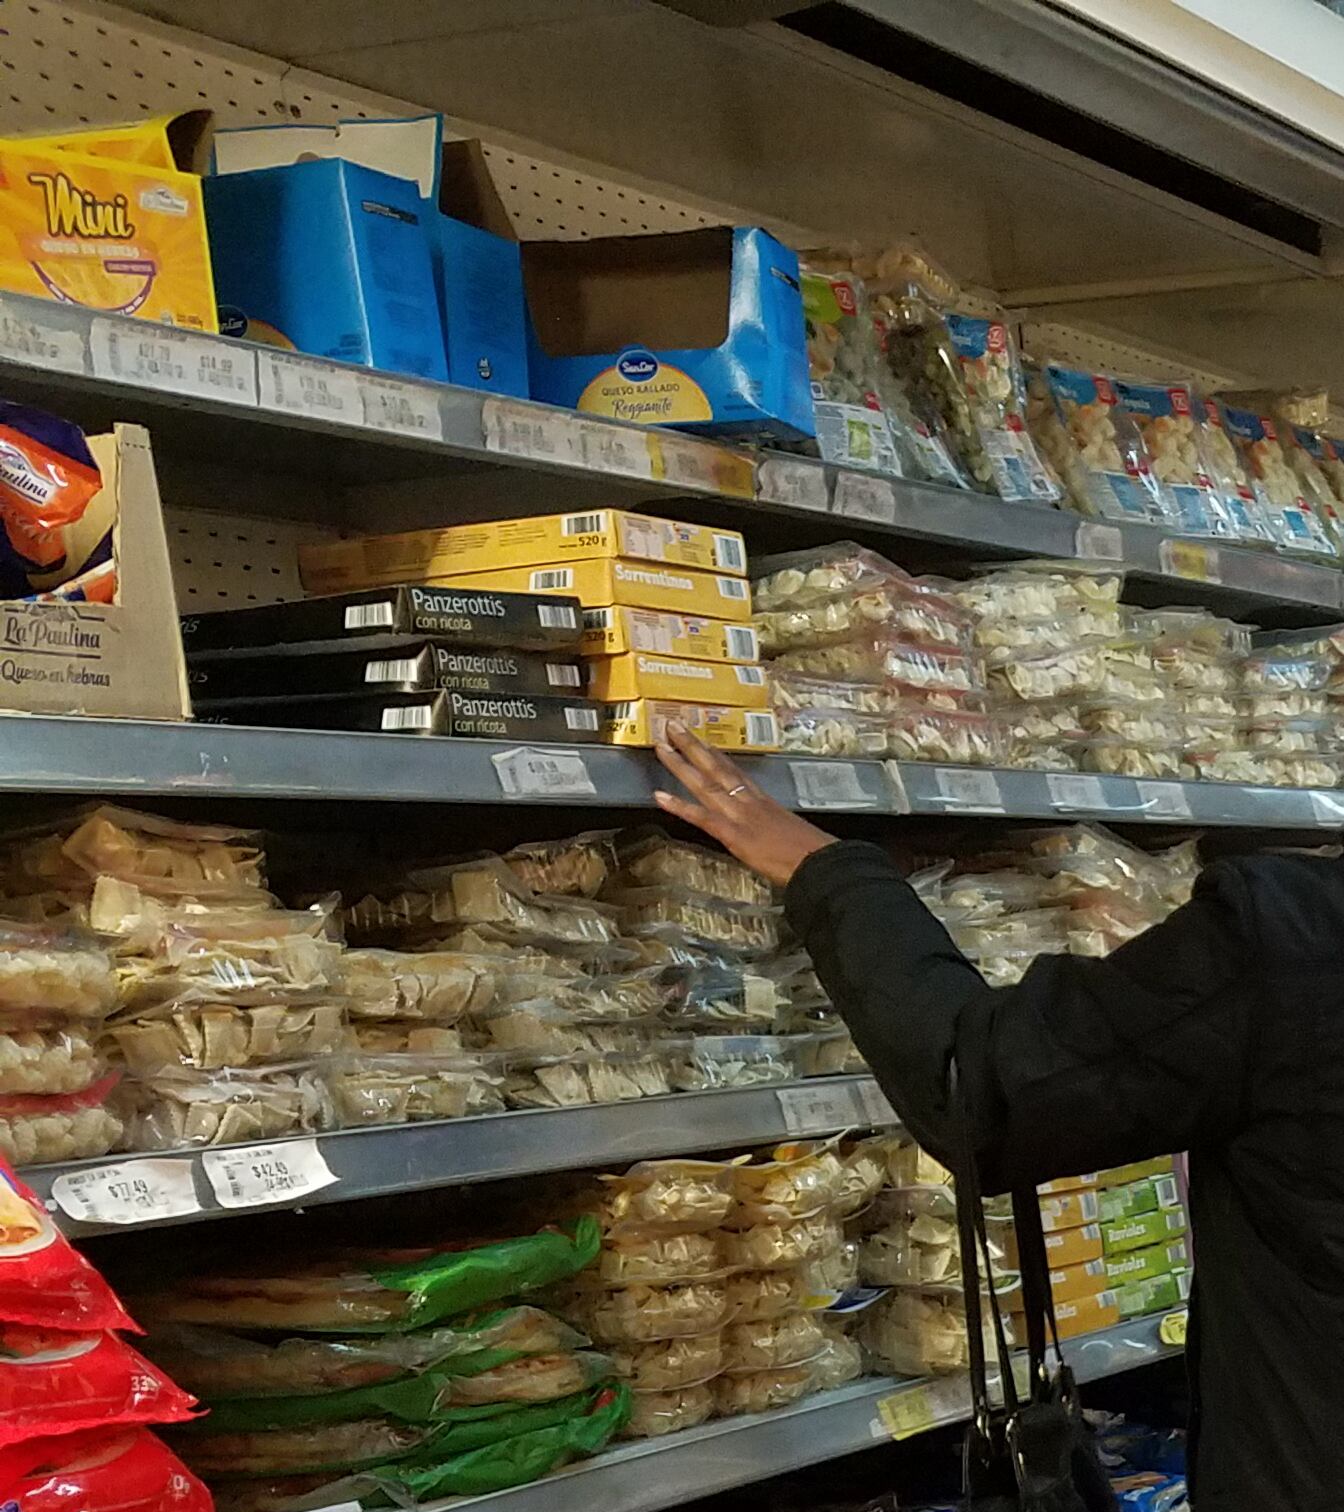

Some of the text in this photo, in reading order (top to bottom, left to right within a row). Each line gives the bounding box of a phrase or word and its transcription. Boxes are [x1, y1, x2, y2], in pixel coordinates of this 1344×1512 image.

[27, 172, 135, 238] Mini
[622, 359, 655, 374] SanCor
[601, 383, 680, 397] QUESO RALLADO
[2, 468, 48, 499] aulina
[578, 535, 600, 548] 520
[411, 588, 506, 617] Panzerottis
[4, 616, 101, 649] La Paulina
[415, 615, 472, 631] con ricota
[436, 649, 518, 676] Panzerottis
[440, 675, 457, 689] con
[451, 693, 537, 719] Panzerottis
[454, 718, 507, 734] con ricota
